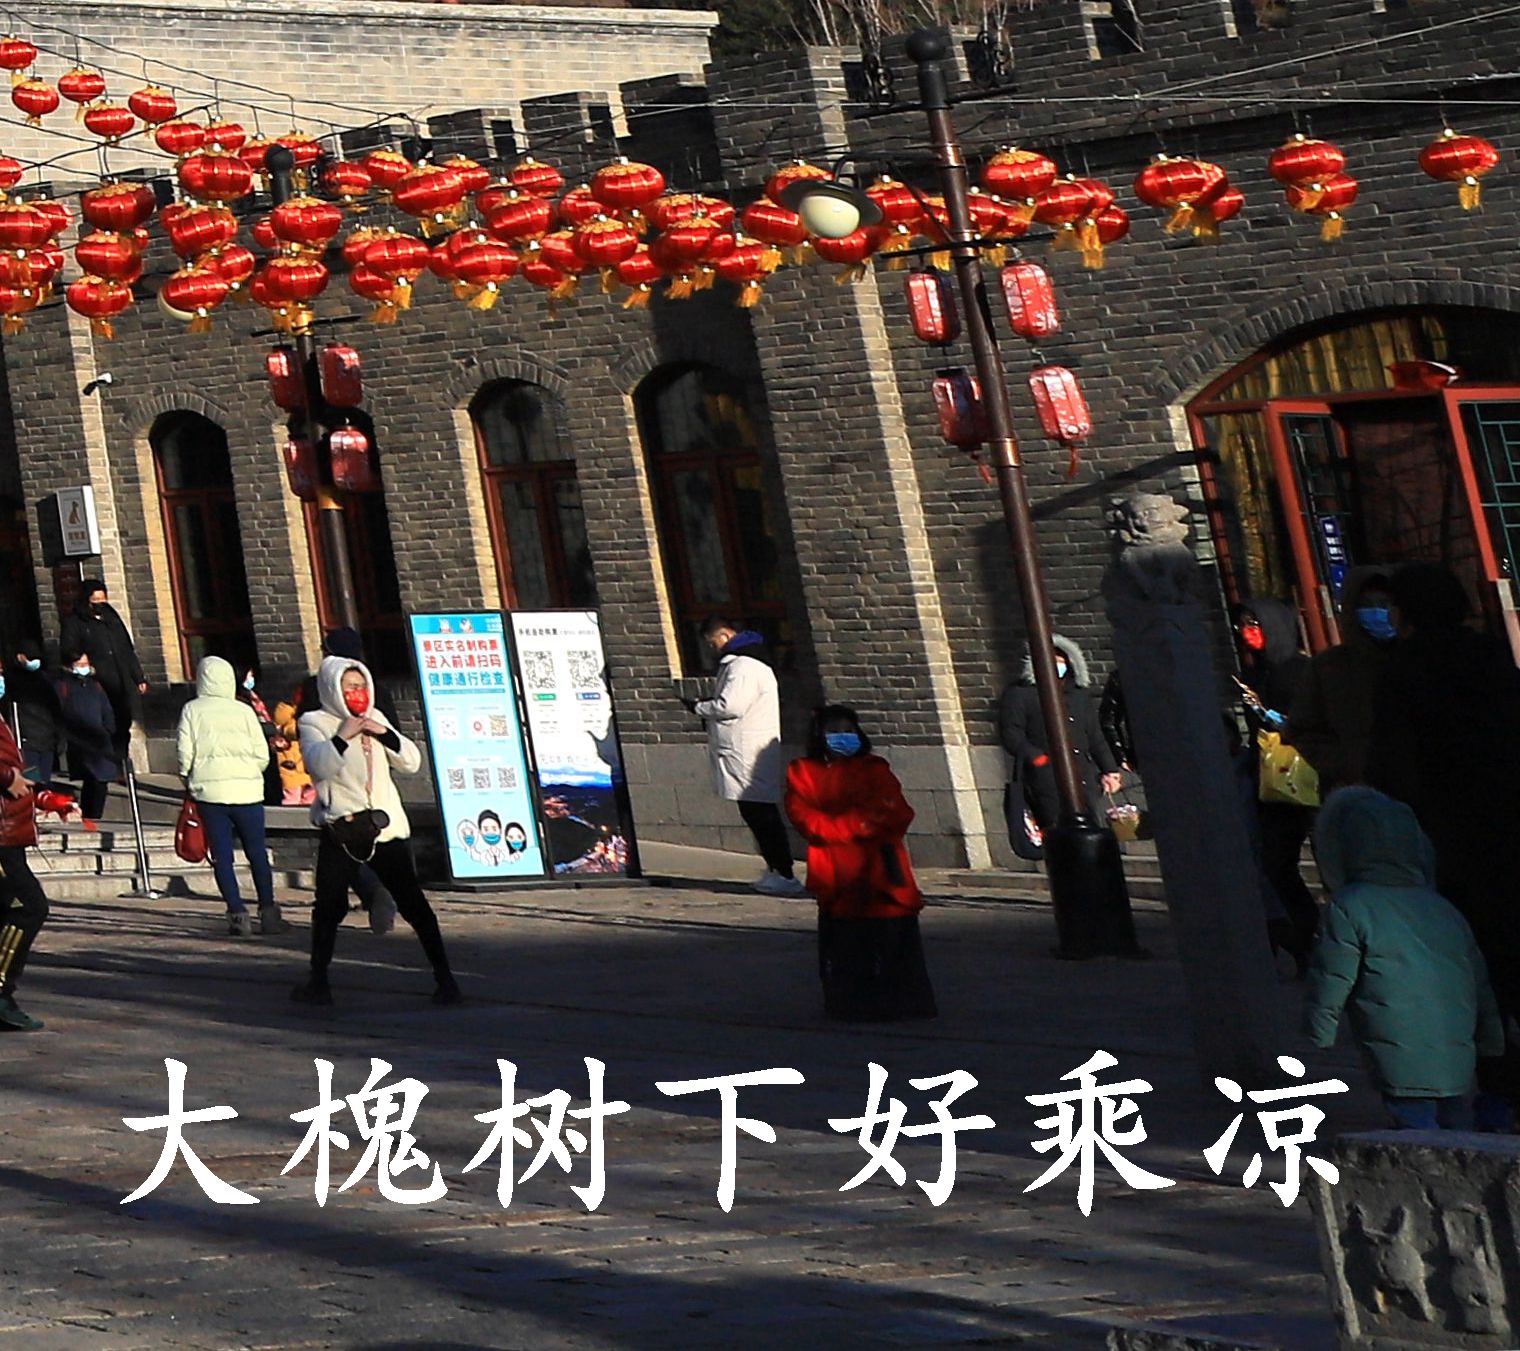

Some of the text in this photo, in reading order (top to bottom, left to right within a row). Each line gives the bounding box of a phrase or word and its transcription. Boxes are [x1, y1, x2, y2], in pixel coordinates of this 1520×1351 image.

[423, 639, 499, 652] 景区实名制购票
[425, 654, 501, 669] 进入前请扫码
[428, 671, 505, 686] 健康通行检查
